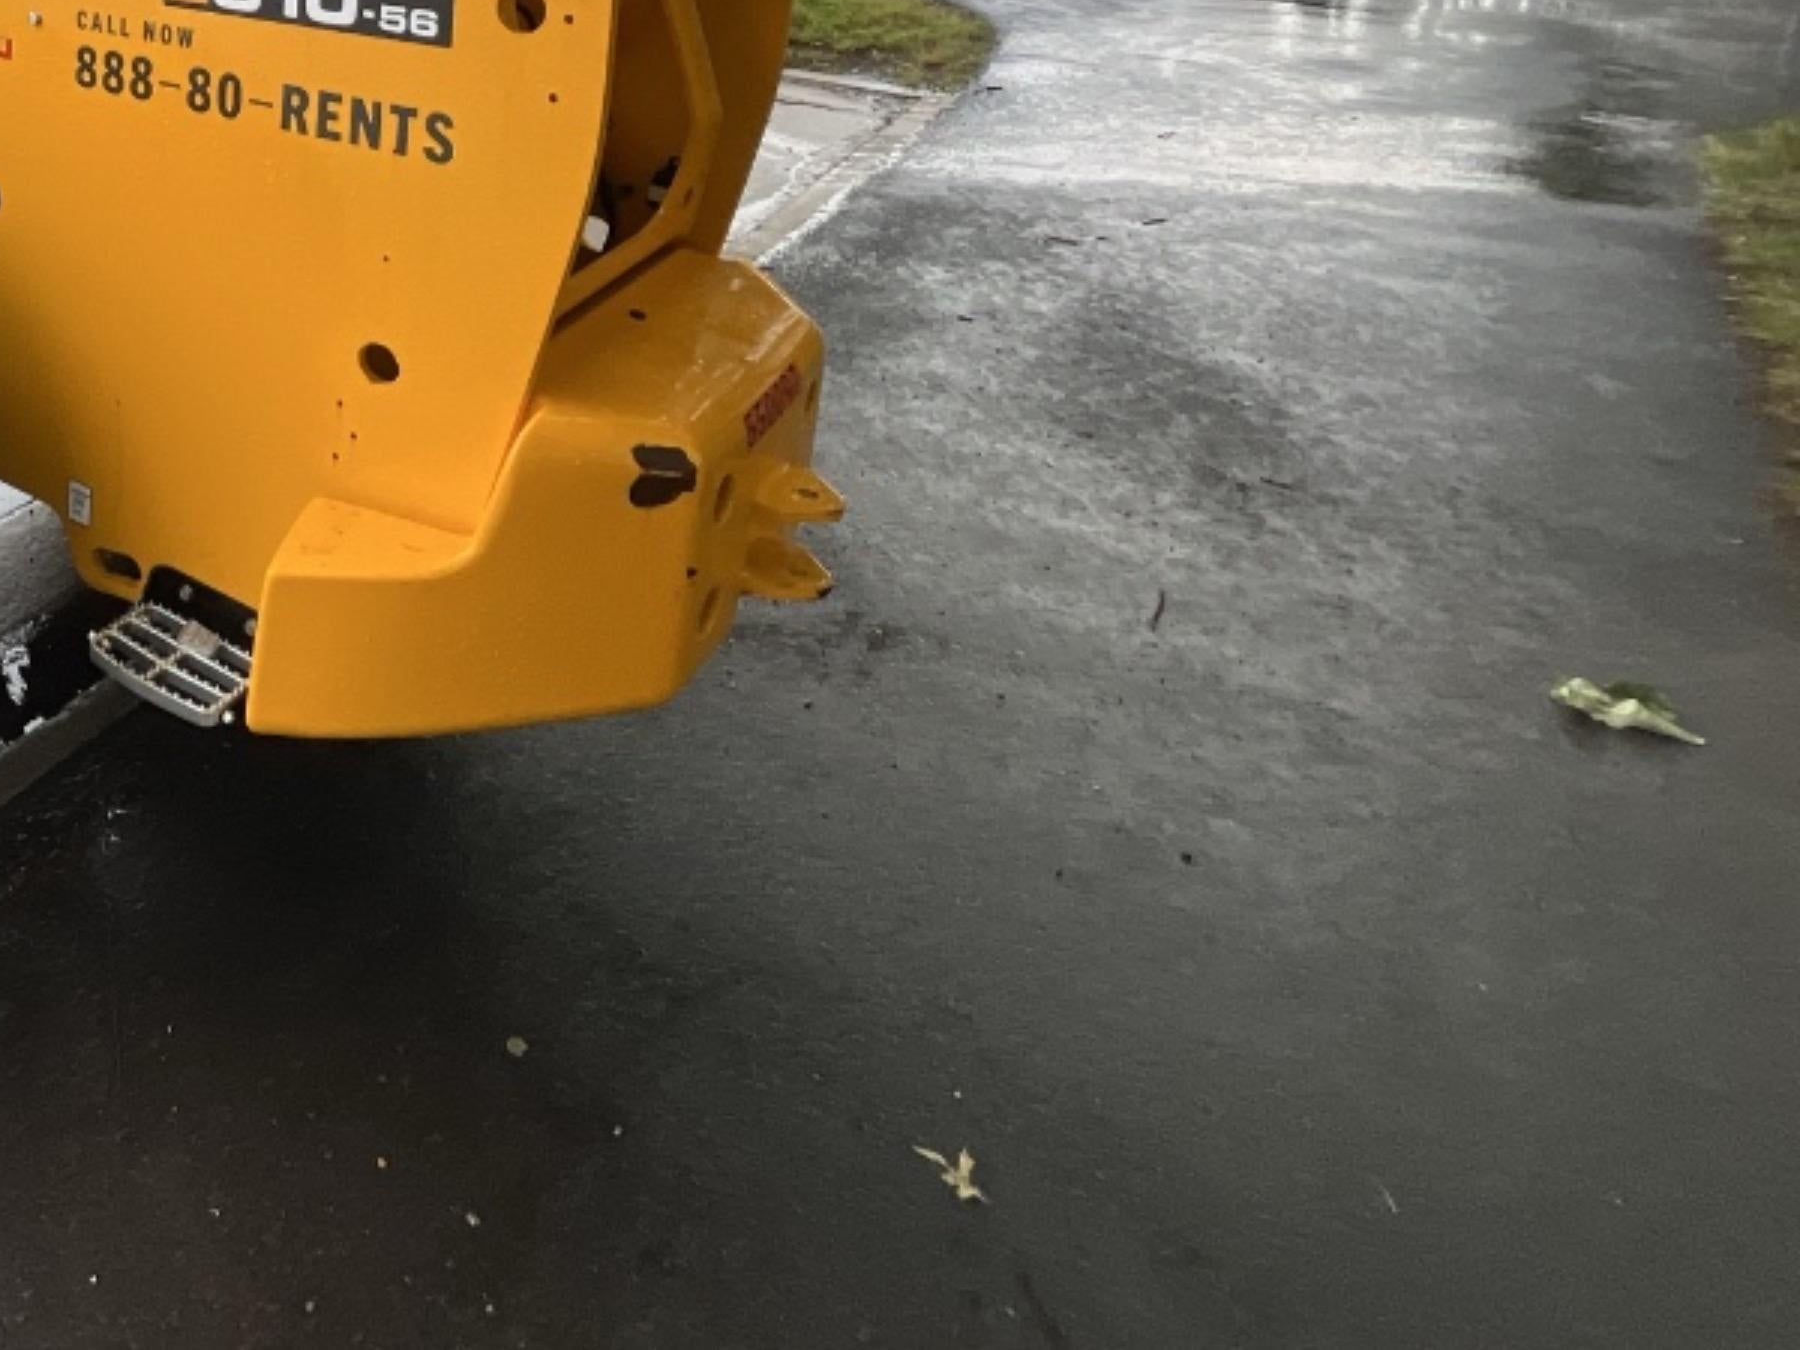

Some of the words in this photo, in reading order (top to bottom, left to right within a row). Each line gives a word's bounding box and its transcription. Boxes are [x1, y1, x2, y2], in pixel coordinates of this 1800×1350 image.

[76, 10, 130, 37] CALL
[142, 20, 195, 49] NOW
[74, 45, 455, 165] 888-80-RENTS
